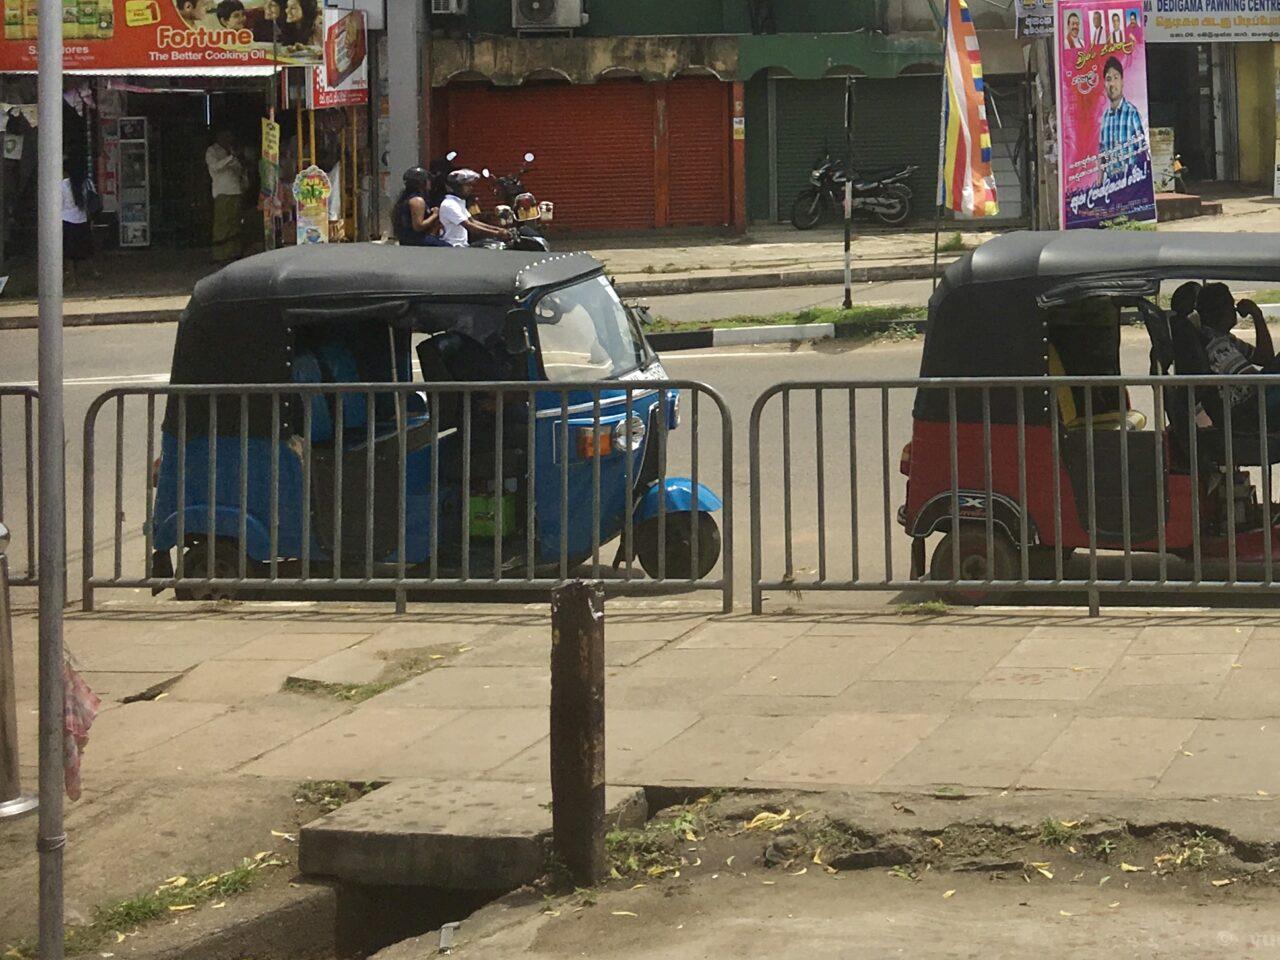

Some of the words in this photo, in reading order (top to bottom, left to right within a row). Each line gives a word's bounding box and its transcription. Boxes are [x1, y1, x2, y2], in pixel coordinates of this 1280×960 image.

[157, 25, 254, 48] Fortune
[150, 50, 169, 61] The
[171, 50, 202, 61] Better
[205, 49, 249, 61] Cooking
[250, 49, 265, 60] Oil
